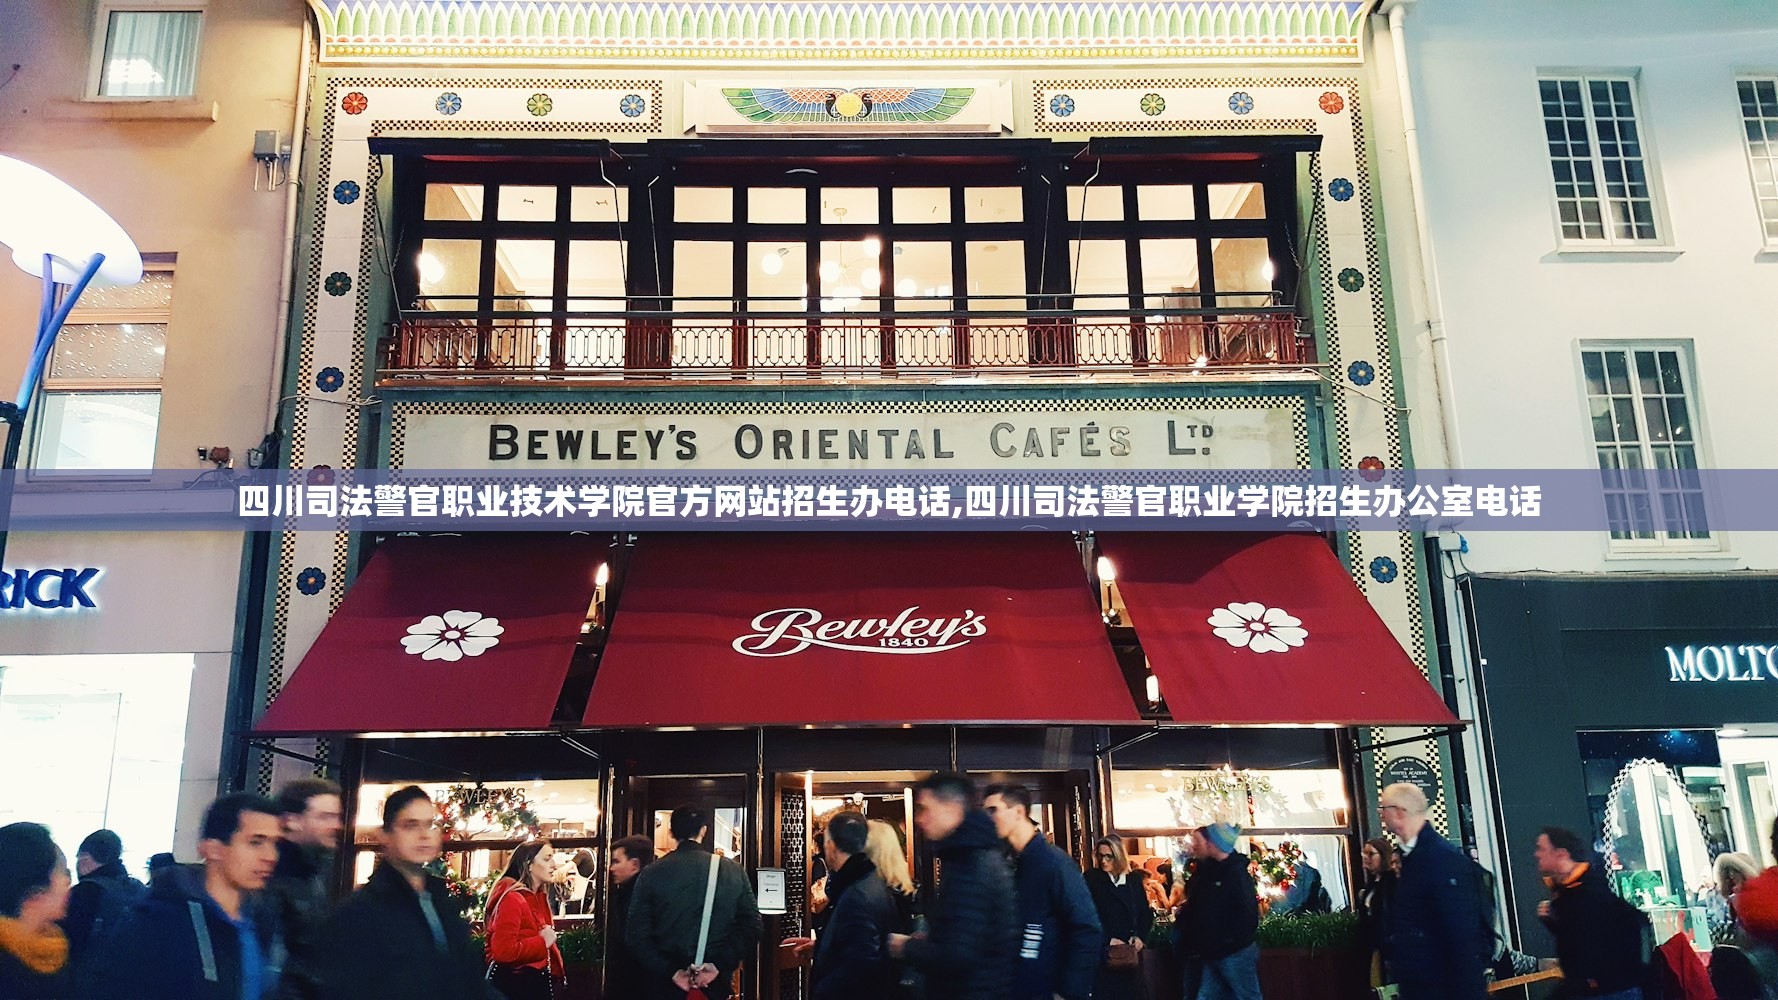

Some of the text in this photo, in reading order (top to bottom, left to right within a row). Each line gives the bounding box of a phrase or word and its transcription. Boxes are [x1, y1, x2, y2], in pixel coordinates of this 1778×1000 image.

[488, 424, 697, 461] BEWLEY'S
[734, 423, 955, 461] ORIENTAL
[989, 420, 1132, 458] CAFÉS
[731, 605, 988, 658] Bewley's
[878, 637, 929, 648] 1840
